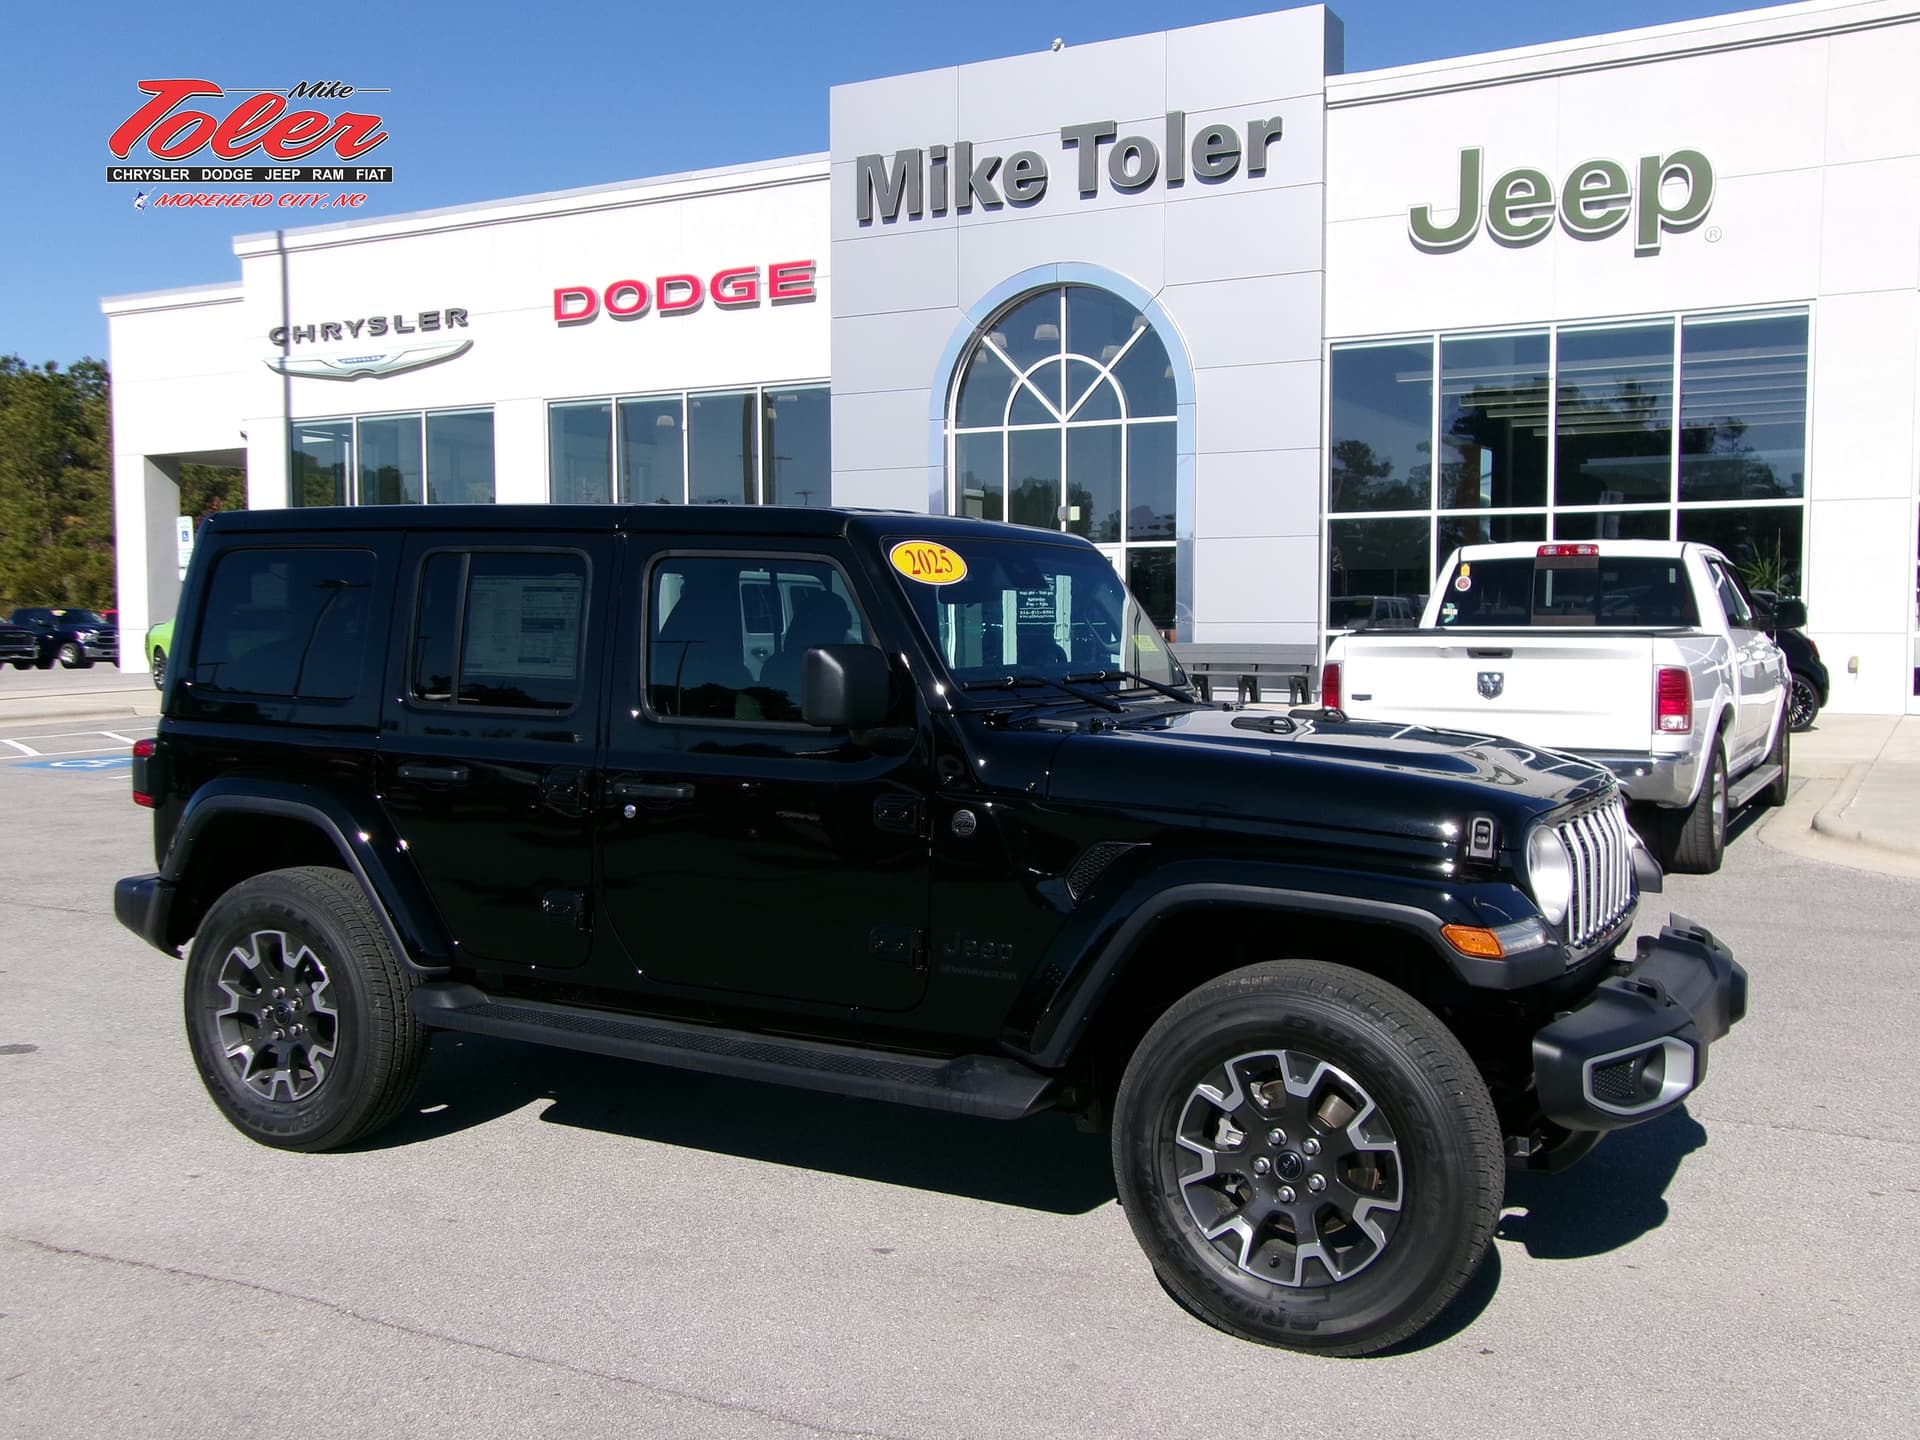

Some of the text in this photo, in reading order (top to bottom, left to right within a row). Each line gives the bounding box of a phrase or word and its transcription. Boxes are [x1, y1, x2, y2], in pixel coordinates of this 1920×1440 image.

[856, 110, 1284, 227] Mike Toler
[1407, 145, 1717, 258] Jeep
[268, 307, 469, 345] CHRYSLER
[553, 259, 816, 326] DODGE
[905, 549, 953, 575] 2025
